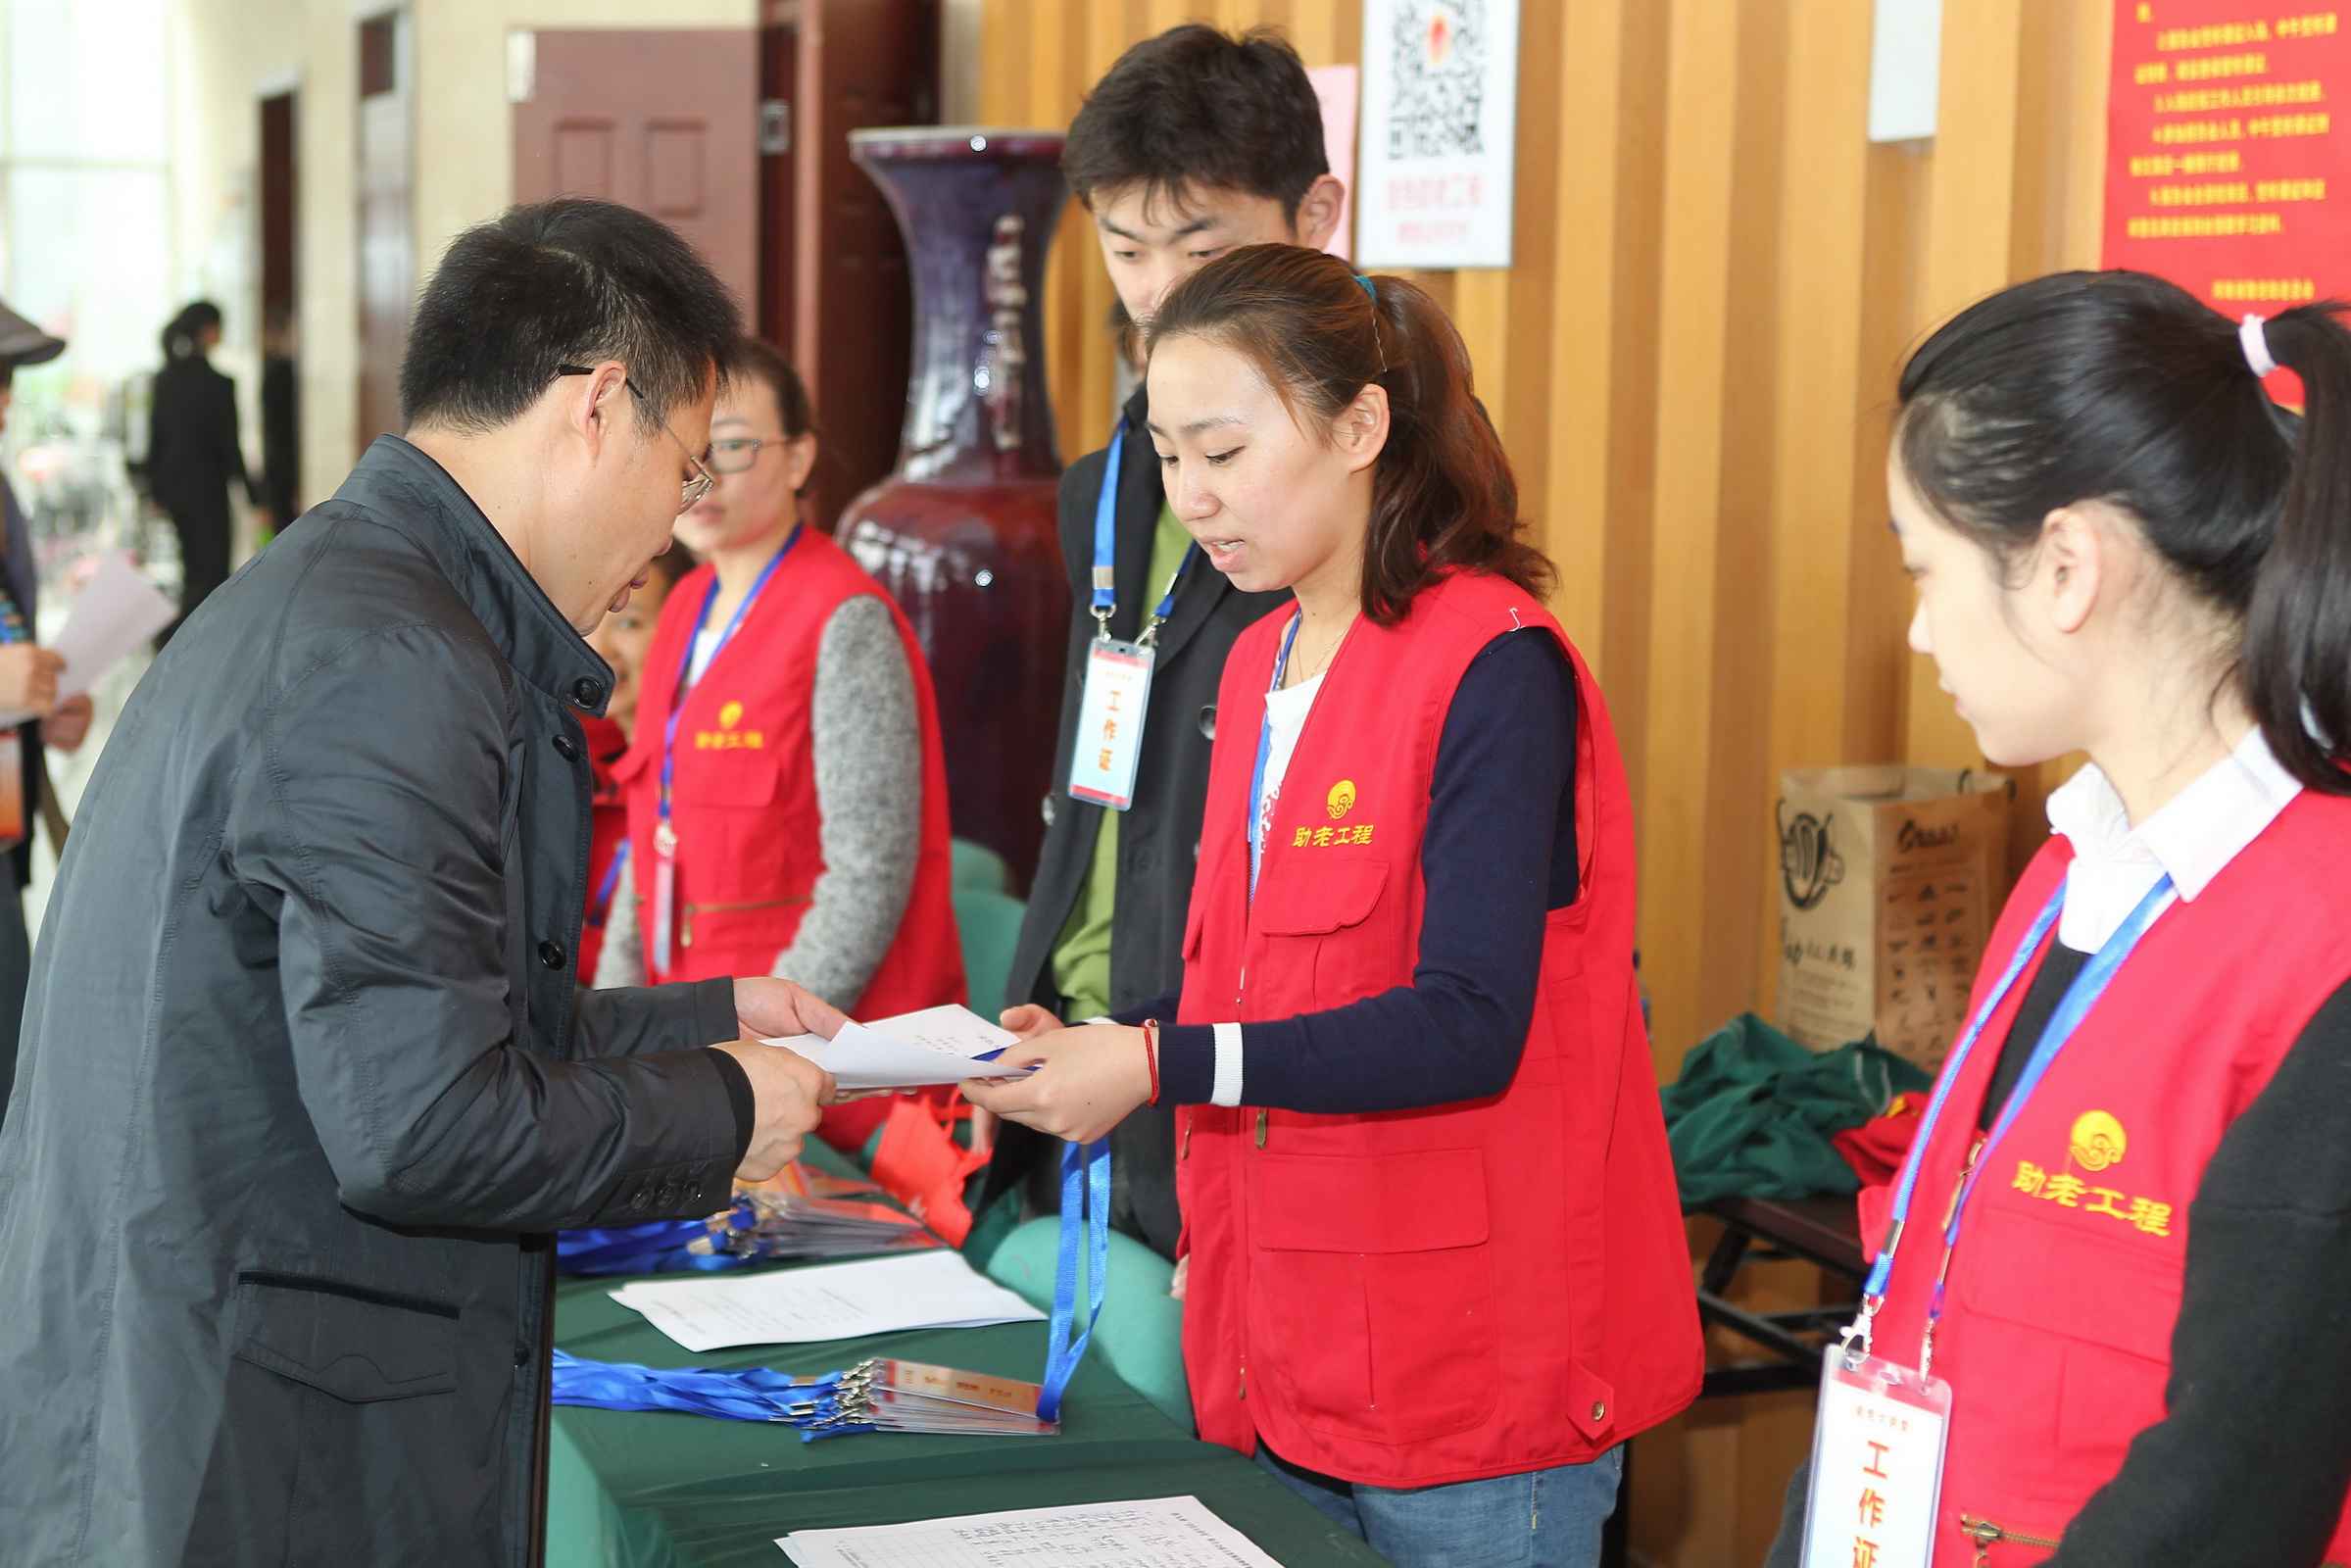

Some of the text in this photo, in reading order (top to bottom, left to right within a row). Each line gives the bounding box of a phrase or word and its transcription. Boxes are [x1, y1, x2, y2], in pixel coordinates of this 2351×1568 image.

[1099, 690, 1122, 771] 工作证
[1293, 824, 1374, 847] 助老工程
[2011, 1160, 2173, 1237] 助老工程
[1851, 1440, 1889, 1568] 工作证
